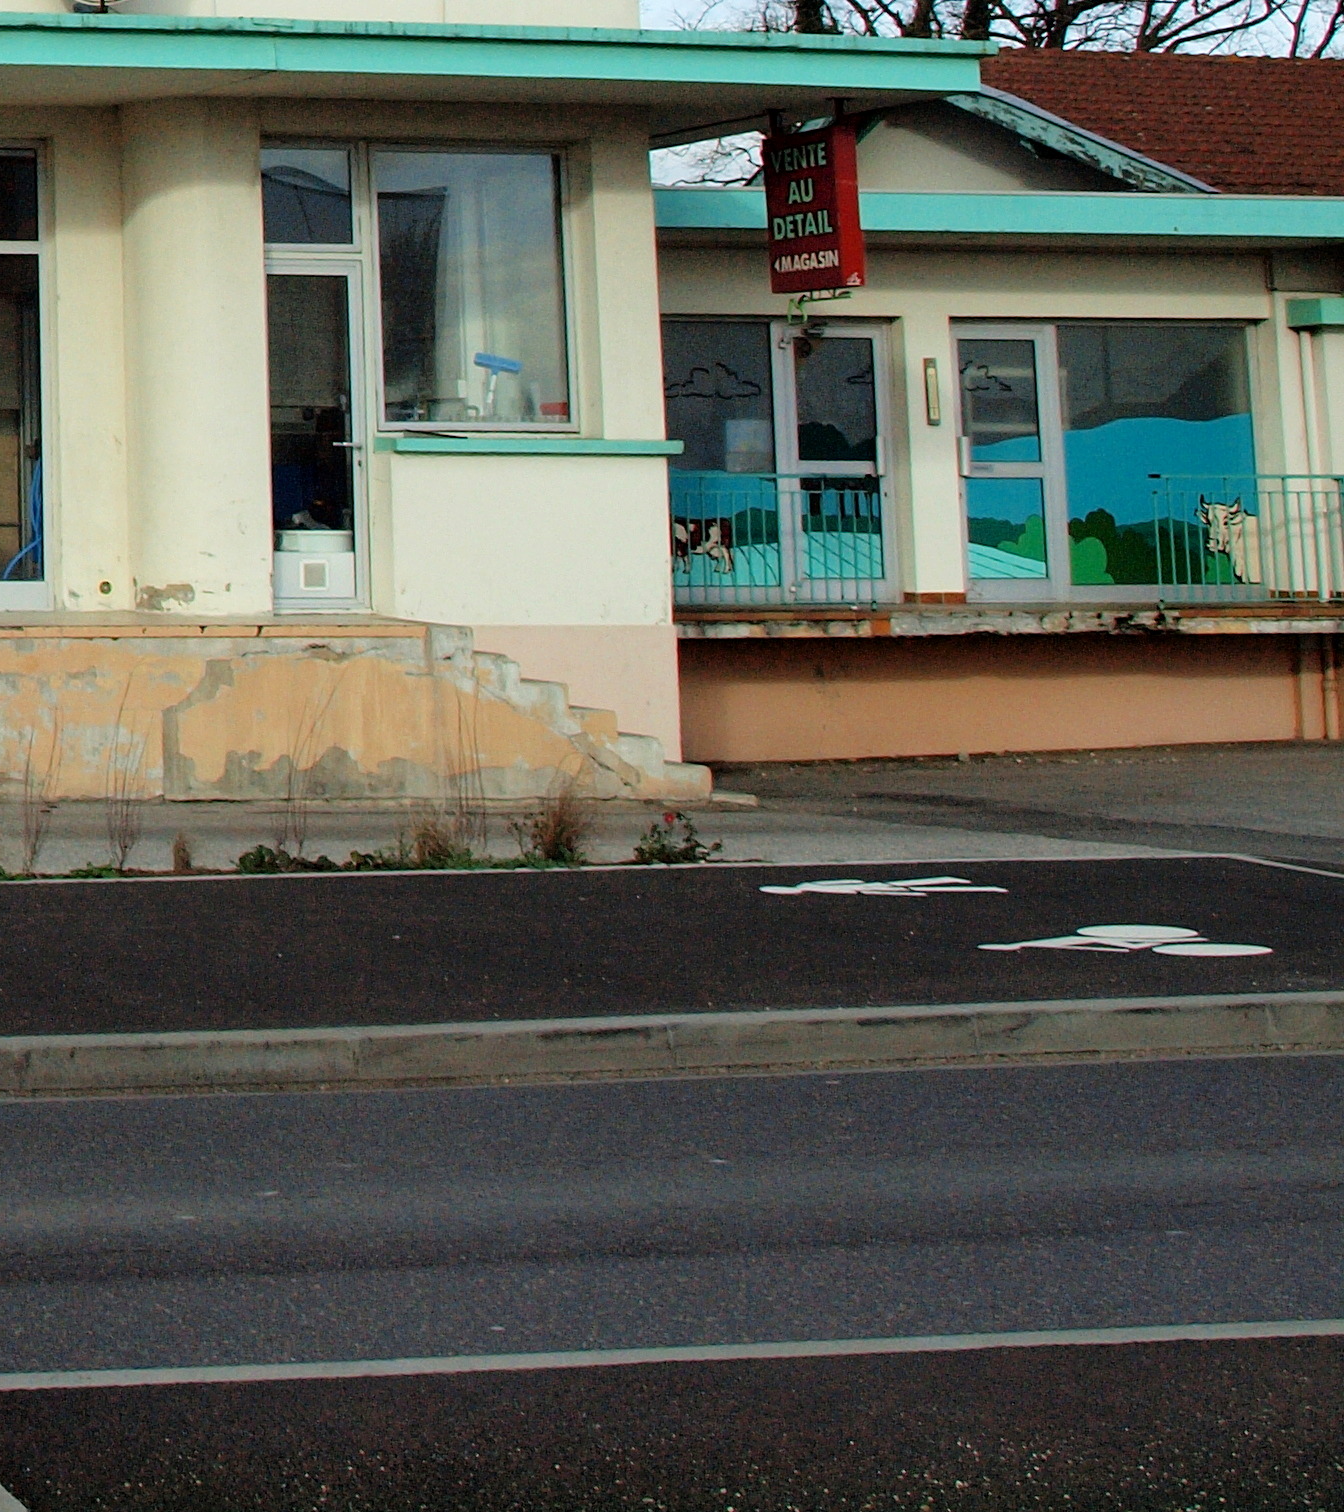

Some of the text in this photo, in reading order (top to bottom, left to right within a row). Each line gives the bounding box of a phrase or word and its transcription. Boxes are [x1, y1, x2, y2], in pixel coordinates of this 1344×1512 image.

[771, 142, 827, 173] VENTE
[788, 178, 814, 204] AU
[773, 210, 833, 240] DETAIL
[780, 249, 840, 273] MAGASIN
